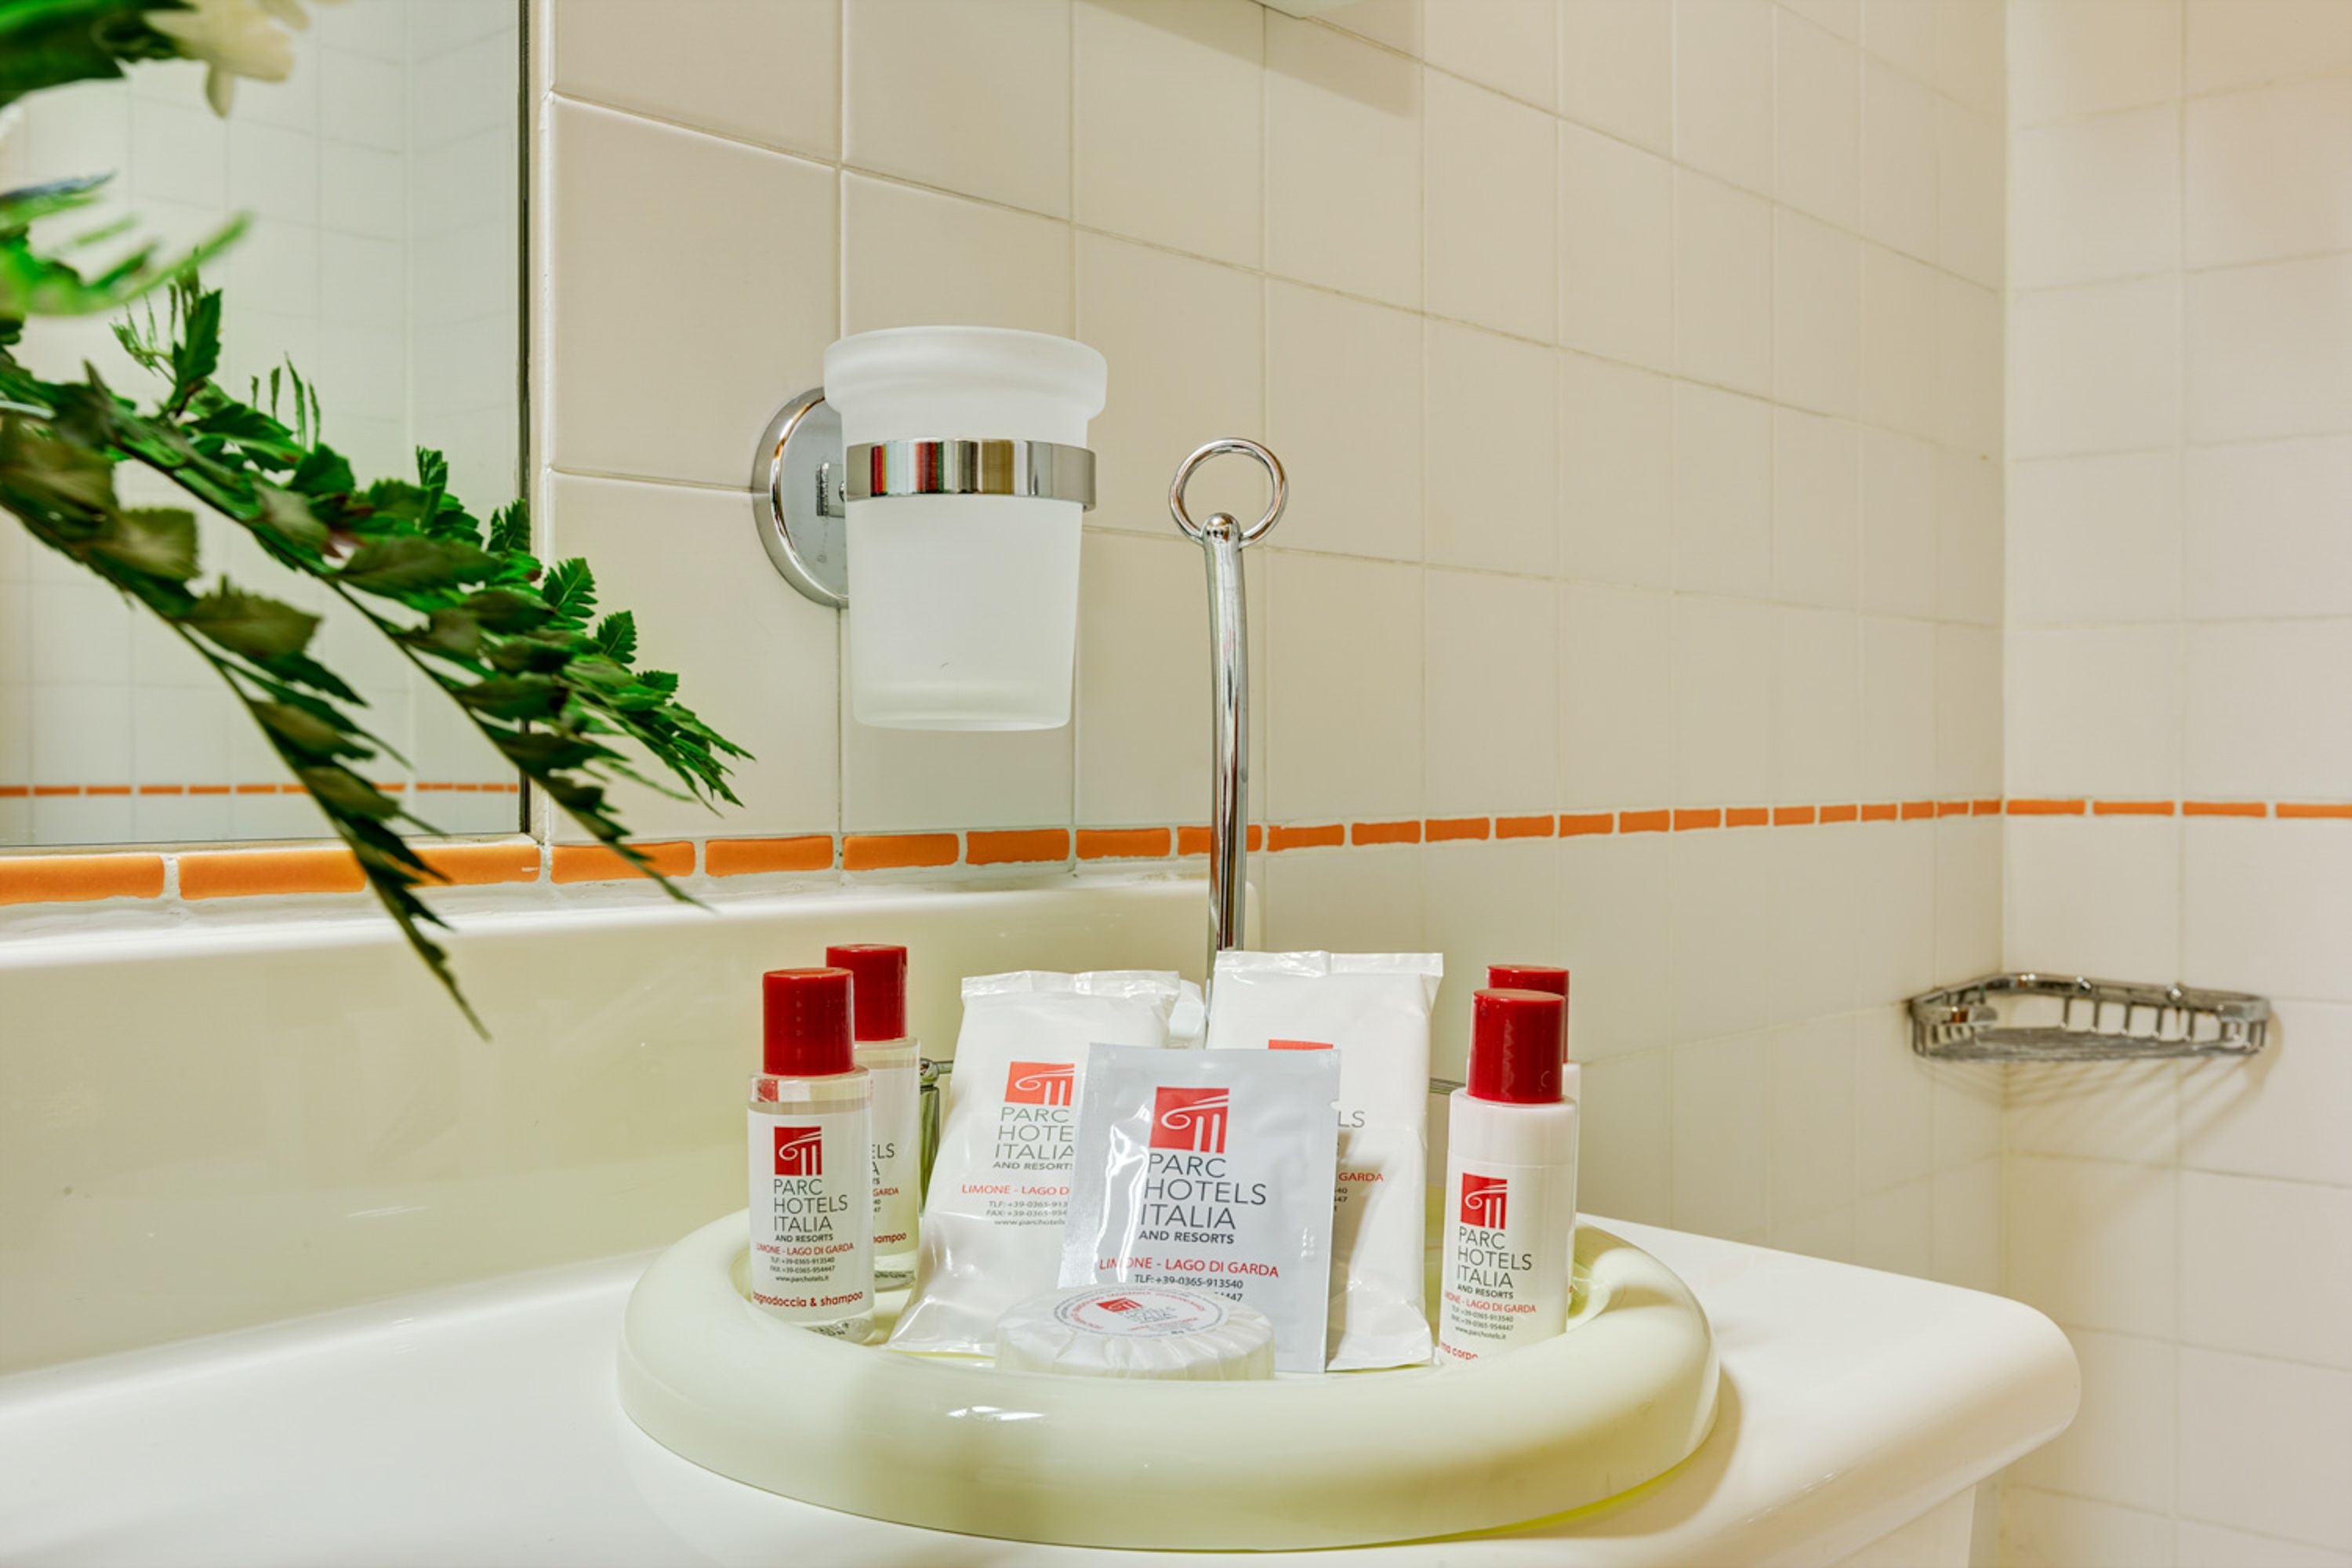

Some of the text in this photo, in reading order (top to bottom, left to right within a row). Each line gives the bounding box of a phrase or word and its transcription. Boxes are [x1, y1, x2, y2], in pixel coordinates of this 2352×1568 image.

[1000, 1107, 1069, 1123] PARC
[993, 1161, 1020, 1170] AND
[1148, 1153, 1226, 1178] PARC
[1338, 1172, 1384, 1181] GARDA
[774, 1178, 822, 1195] PARC
[961, 1185, 1011, 1195] LIMONE
[1022, 1185, 1057, 1195] LAGO
[1144, 1178, 1266, 1206] HOTELS
[774, 1194, 848, 1214] HOTELS
[774, 1215, 833, 1232] ITALIA
[1141, 1204, 1236, 1229] ITALIA
[795, 1234, 833, 1243] RESORTS
[1138, 1231, 1235, 1244] AND RESORTS
[1459, 1226, 1505, 1250] PARC
[786, 1247, 811, 1255] LAGO
[825, 1242, 855, 1254] GARDA
[1457, 1245, 1532, 1270] HOTELS
[1166, 1259, 1205, 1272] LAGO
[1209, 1261, 1224, 1272] DI
[1229, 1262, 1279, 1278] GARDA
[1457, 1265, 1513, 1289] ITALIA
[810, 1297, 817, 1307] &
[820, 1290, 863, 1306] shampoo
[1457, 1284, 1513, 1299] AND RESORTS
[1466, 1298, 1490, 1310] LAGO
[1492, 1302, 1501, 1312] DI
[1504, 1304, 1537, 1313] GARDA
